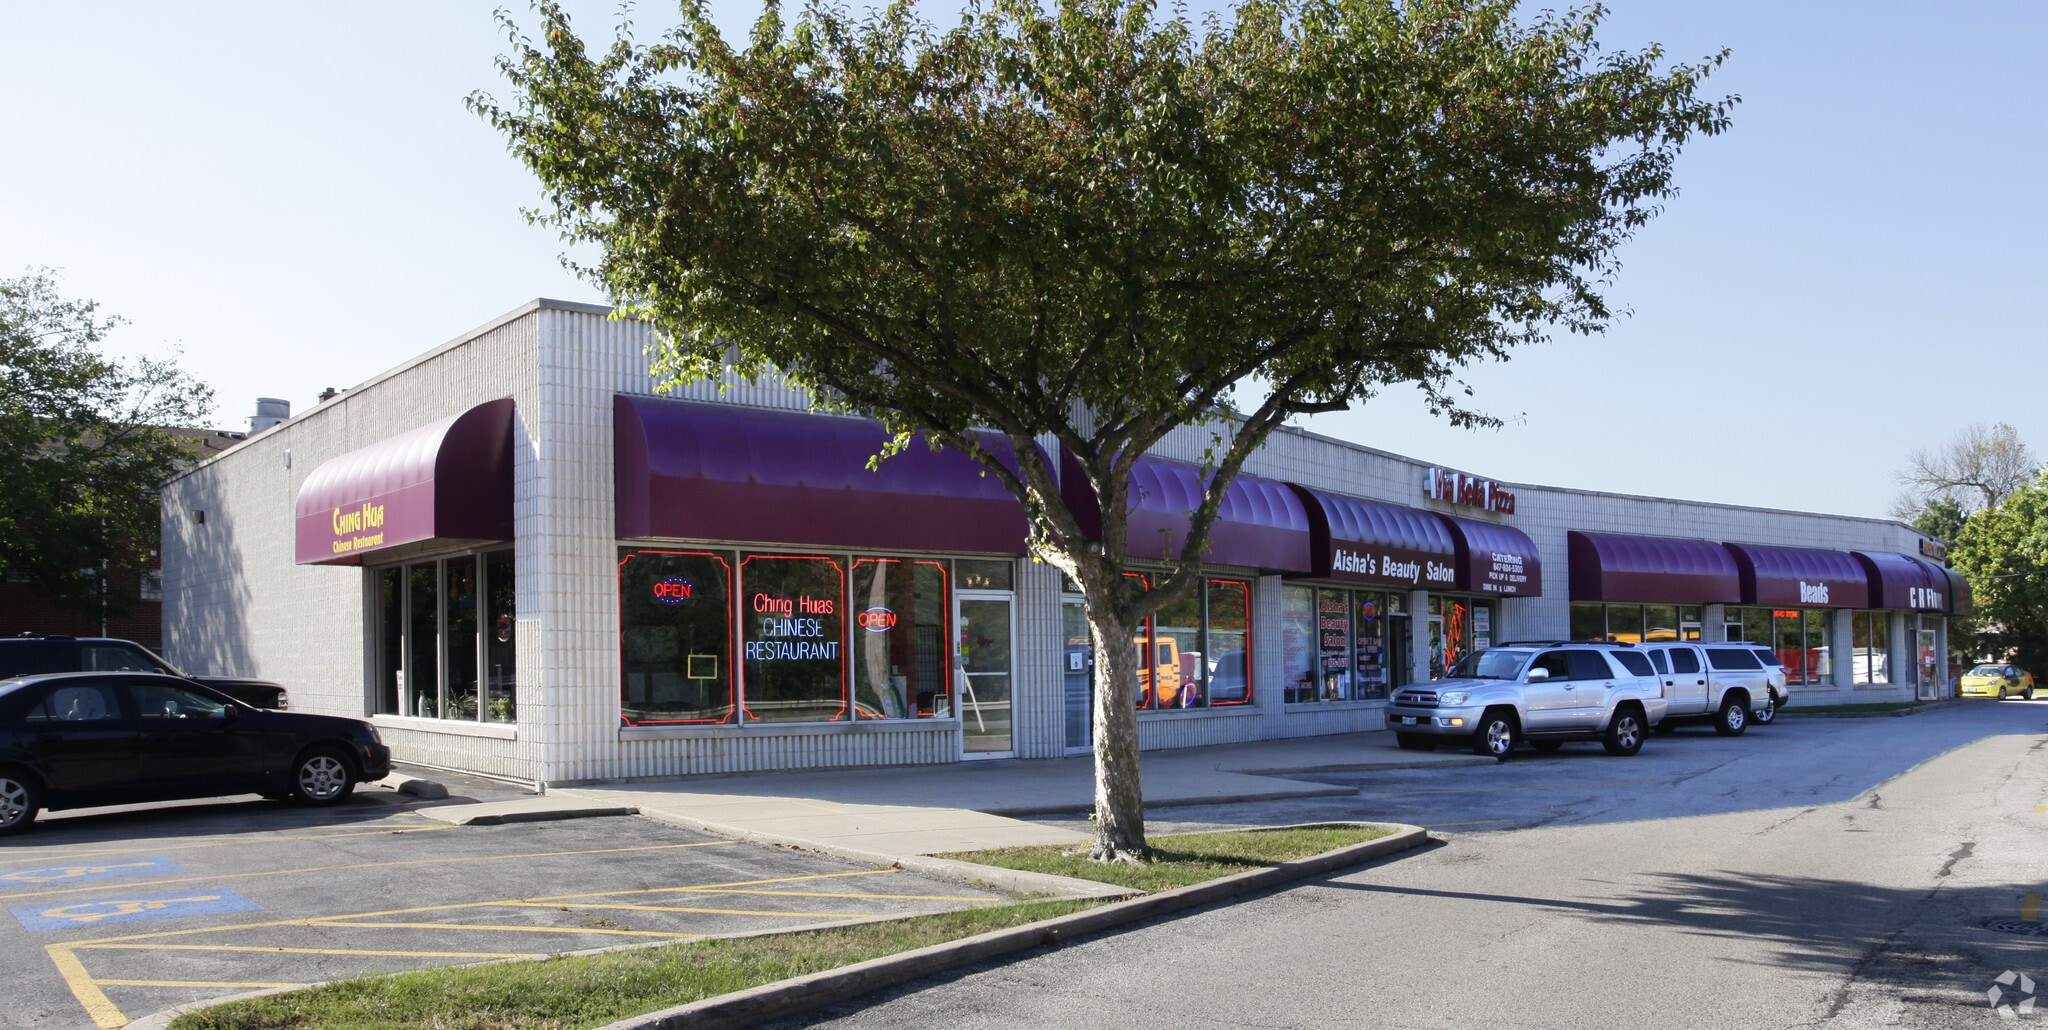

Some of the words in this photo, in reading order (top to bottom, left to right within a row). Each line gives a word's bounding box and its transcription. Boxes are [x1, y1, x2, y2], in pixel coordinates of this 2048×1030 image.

[1430, 467, 1454, 501] Via
[1453, 473, 1485, 508] Bella
[1484, 481, 1515, 514] Pizza
[333, 540, 352, 553] Chinese
[353, 531, 383, 550] Restaurant
[1333, 549, 1376, 575] Aisha's
[1382, 555, 1420, 584] Beauty
[1426, 560, 1454, 582] Salon
[1492, 552, 1522, 564] CATERING
[1489, 571, 1498, 580] PICK
[1499, 572, 1504, 580] UP
[1509, 574, 1527, 582] DELIVERY
[653, 583, 691, 598] OPEN
[1800, 581, 1829, 604] Beads
[1910, 587, 1916, 608] C
[1918, 587, 1925, 608] R
[753, 593, 793, 618] Ching
[799, 595, 834, 615] Huas
[763, 617, 824, 637] CHINESE
[857, 612, 897, 627] OPEN
[1320, 616, 1349, 633] Beauty
[1324, 632, 1347, 646] Salon
[746, 641, 839, 660] RESTAURANT
